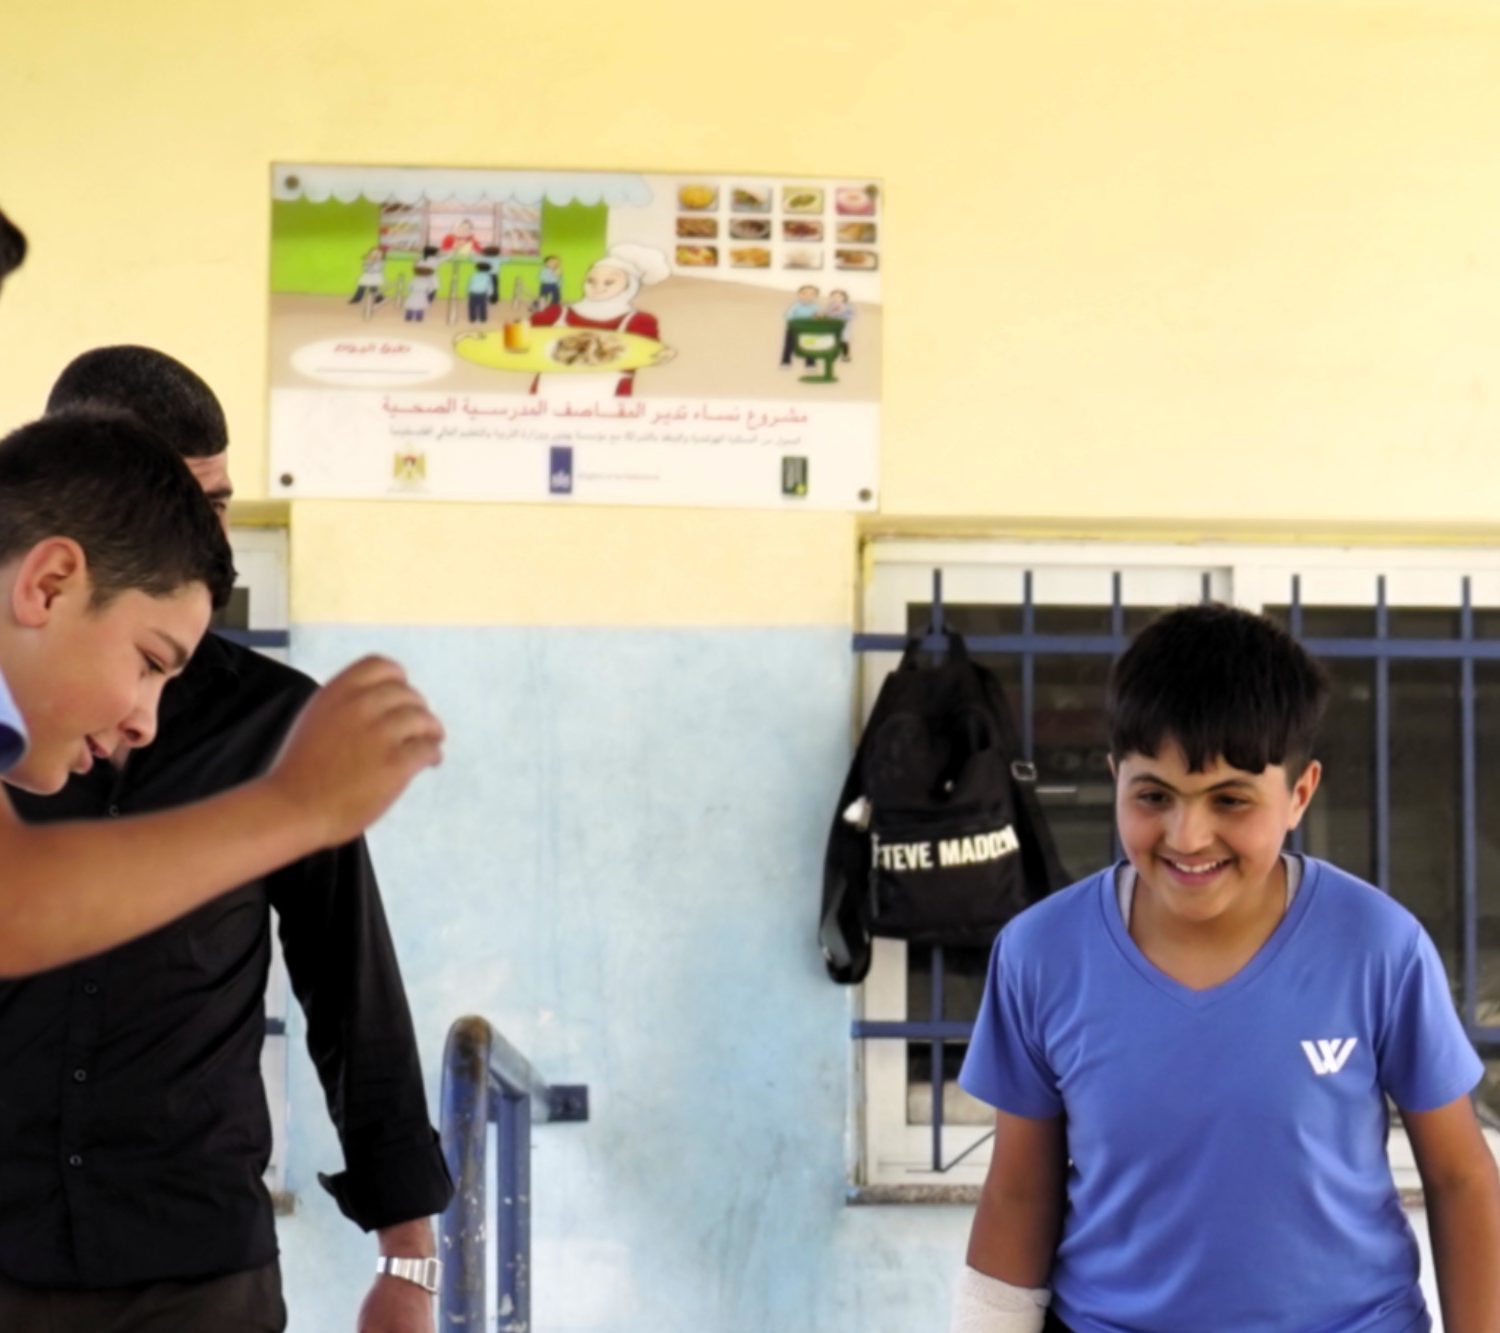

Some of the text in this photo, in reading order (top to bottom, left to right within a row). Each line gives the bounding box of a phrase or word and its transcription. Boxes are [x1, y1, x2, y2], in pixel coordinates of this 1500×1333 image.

[383, 396, 457, 418] الصحية
[461, 397, 548, 421] المدرسية
[650, 401, 688, 424] تدير
[693, 401, 741, 422] نساء
[746, 404, 809, 430] مشروع
[872, 837, 934, 871] TEVE
